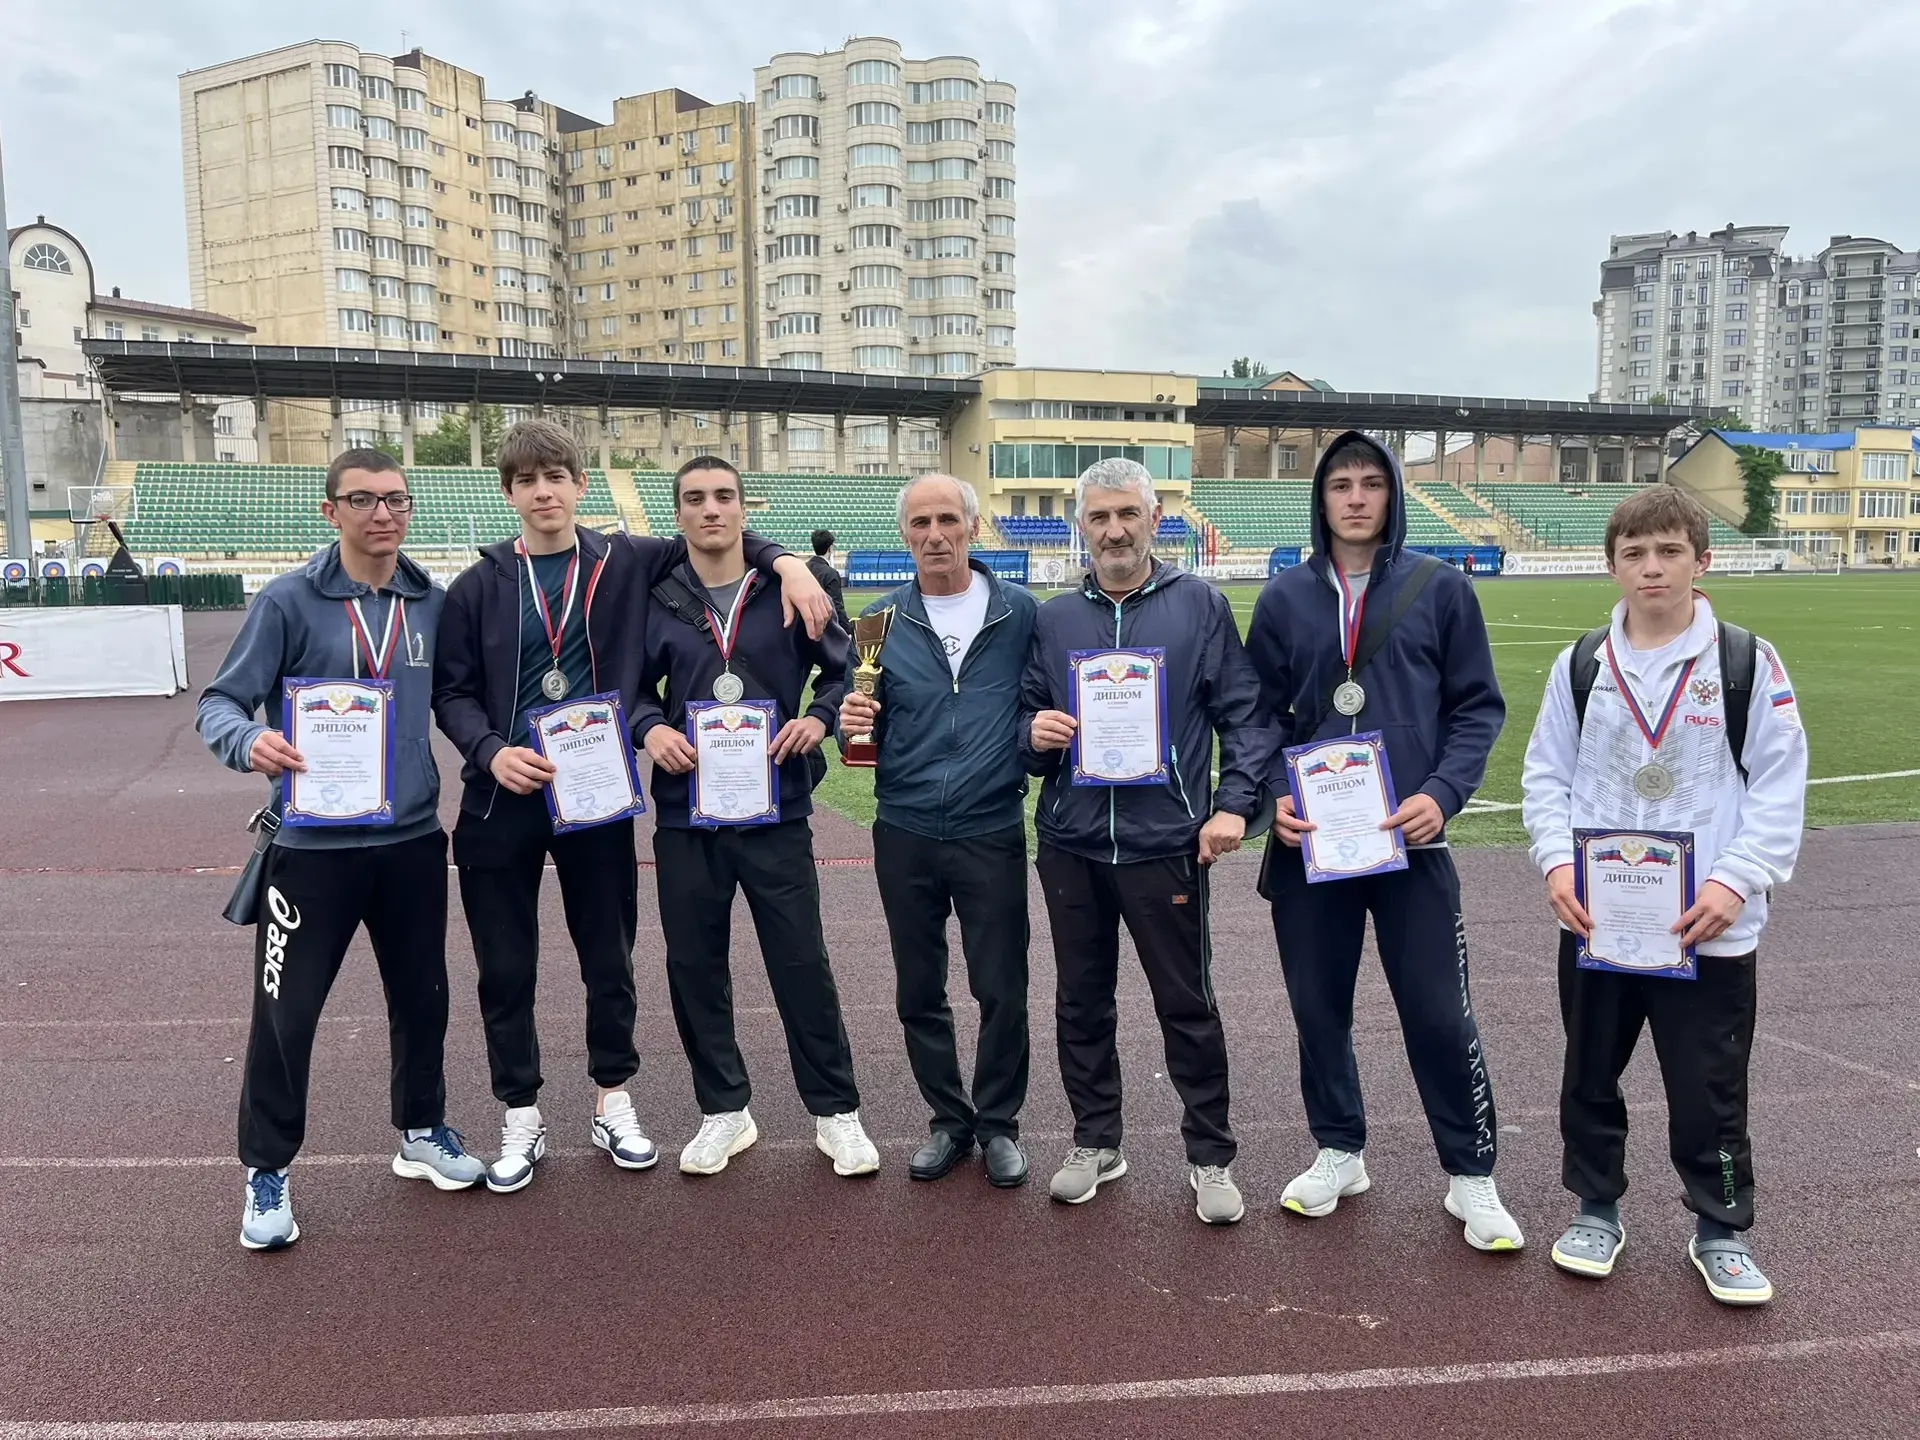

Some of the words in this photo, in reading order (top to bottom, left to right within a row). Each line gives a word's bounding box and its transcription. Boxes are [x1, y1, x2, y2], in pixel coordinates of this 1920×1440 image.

[551, 679, 561, 691] 2
[1092, 690, 1142, 702] ДИПЛОМ
[1343, 692, 1354, 705] 2
[1684, 715, 1720, 726] RUS
[311, 723, 368, 734] ДИПЛОМ
[559, 734, 606, 753] ДИПЛОМ
[709, 739, 755, 750] ДИПЛОМ
[1316, 777, 1366, 795] ДИПЛОМ
[1602, 873, 1664, 885] ДИПЛОМ
[263, 922, 289, 1000] asics
[1467, 1037, 1495, 1158] EXCHANGE
